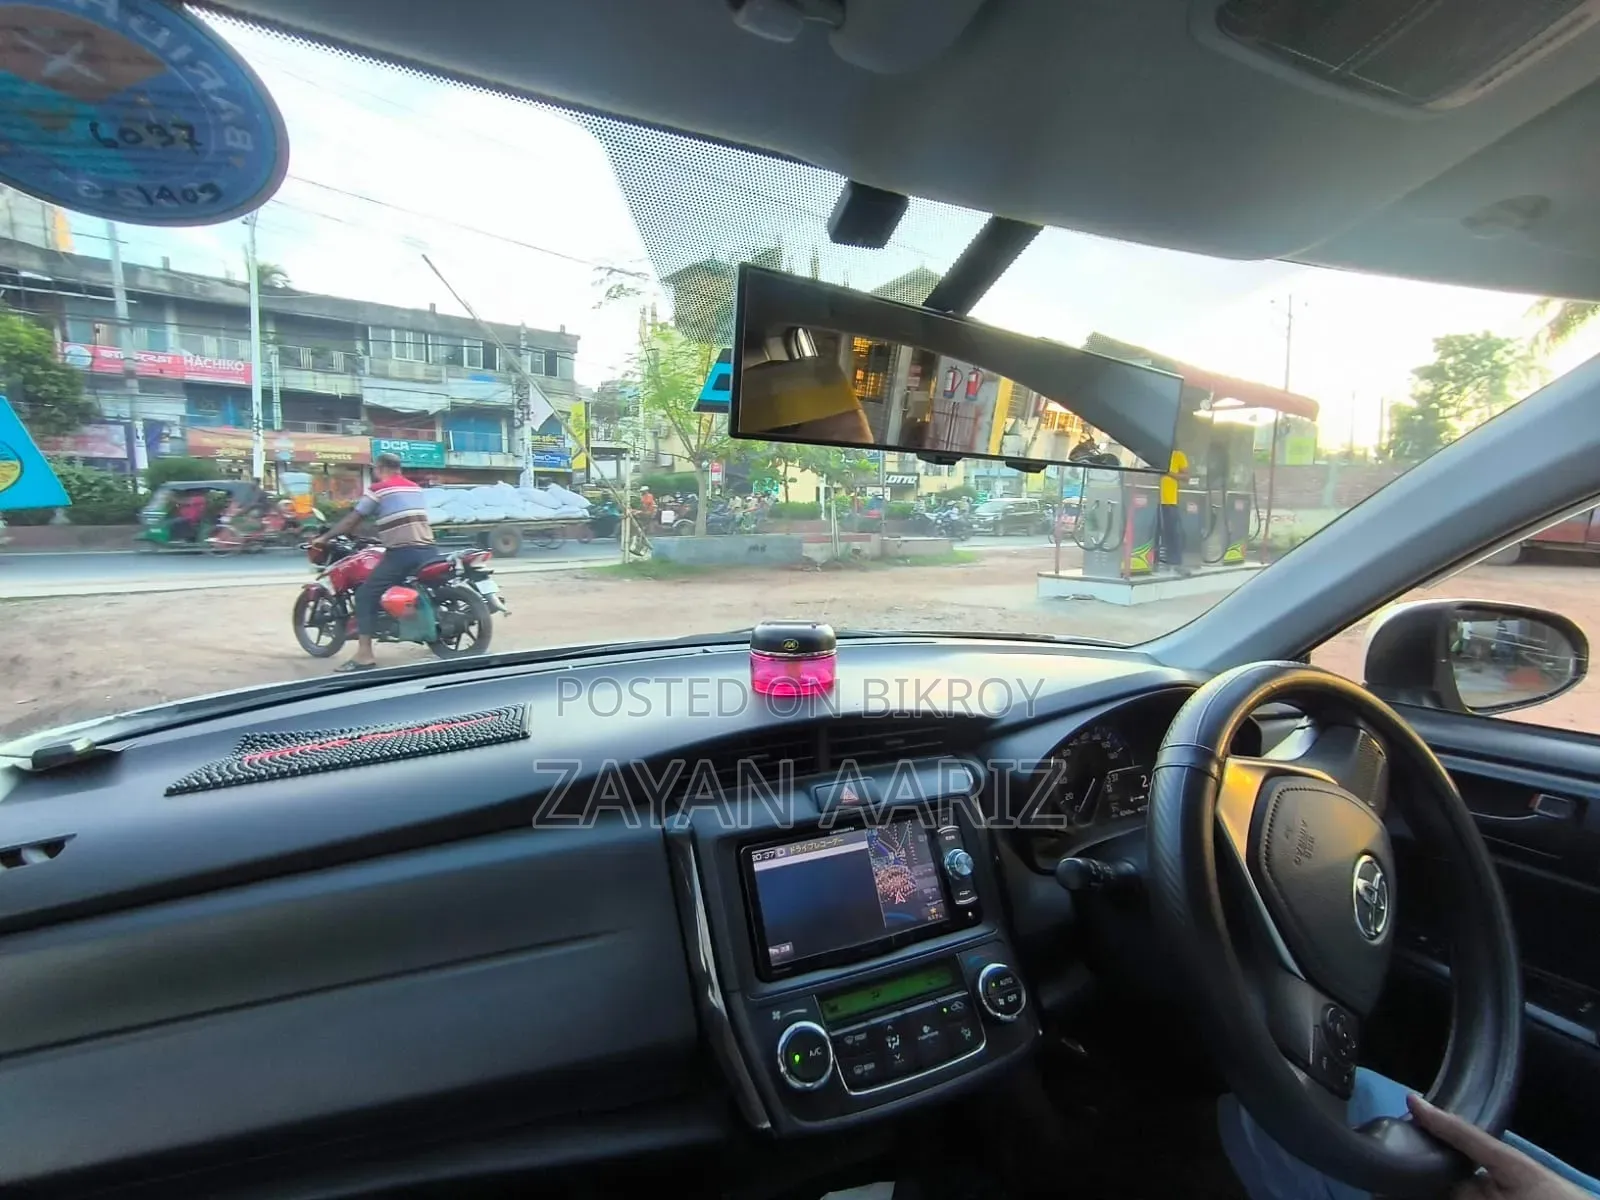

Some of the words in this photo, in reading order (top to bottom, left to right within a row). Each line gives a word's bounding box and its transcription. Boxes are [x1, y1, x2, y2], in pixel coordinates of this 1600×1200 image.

[183, 355, 245, 372] HACHIKO
[885, 474, 918, 484] LOTTO
[809, 1047, 822, 1057] A/C
